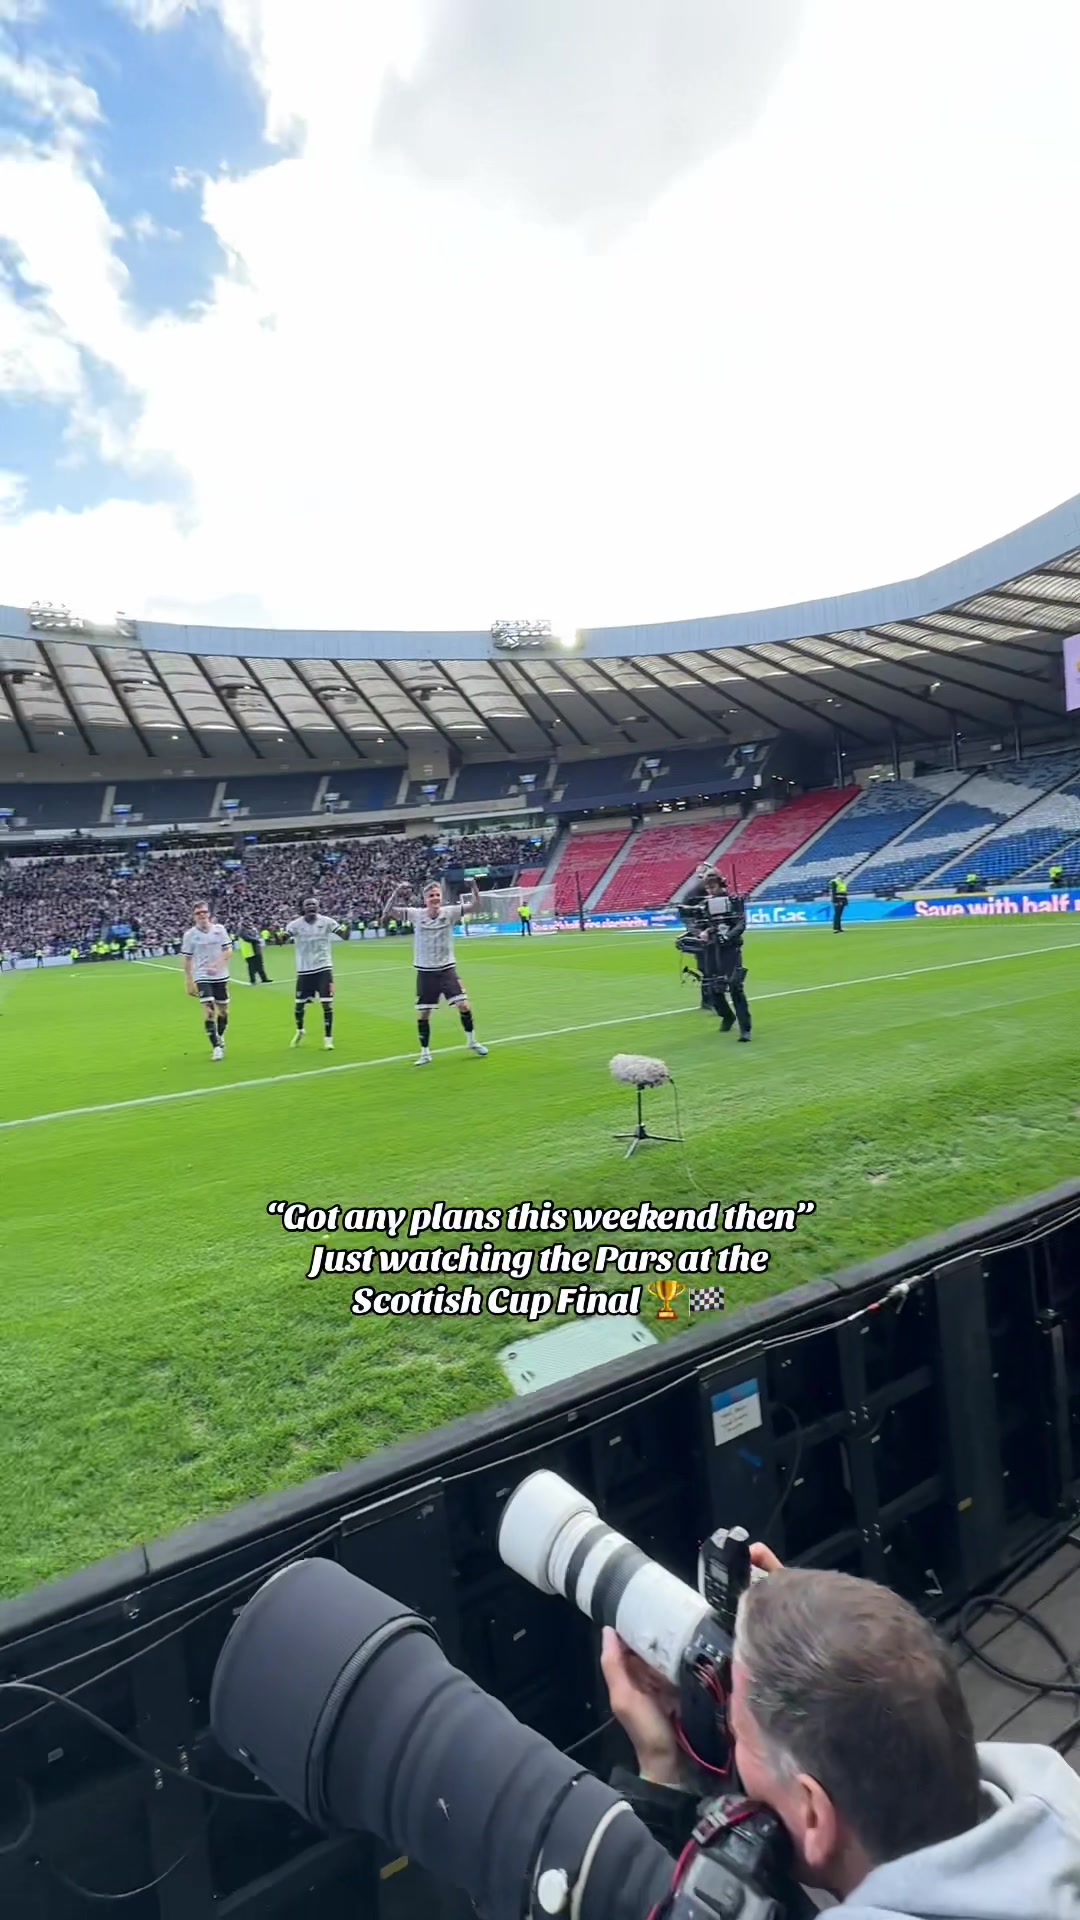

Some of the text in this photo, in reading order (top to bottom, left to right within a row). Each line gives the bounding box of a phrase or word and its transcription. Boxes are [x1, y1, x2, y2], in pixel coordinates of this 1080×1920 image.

[915, 901, 966, 917] Save
[967, 897, 1019, 915] with
[1022, 894, 1070, 914] half
